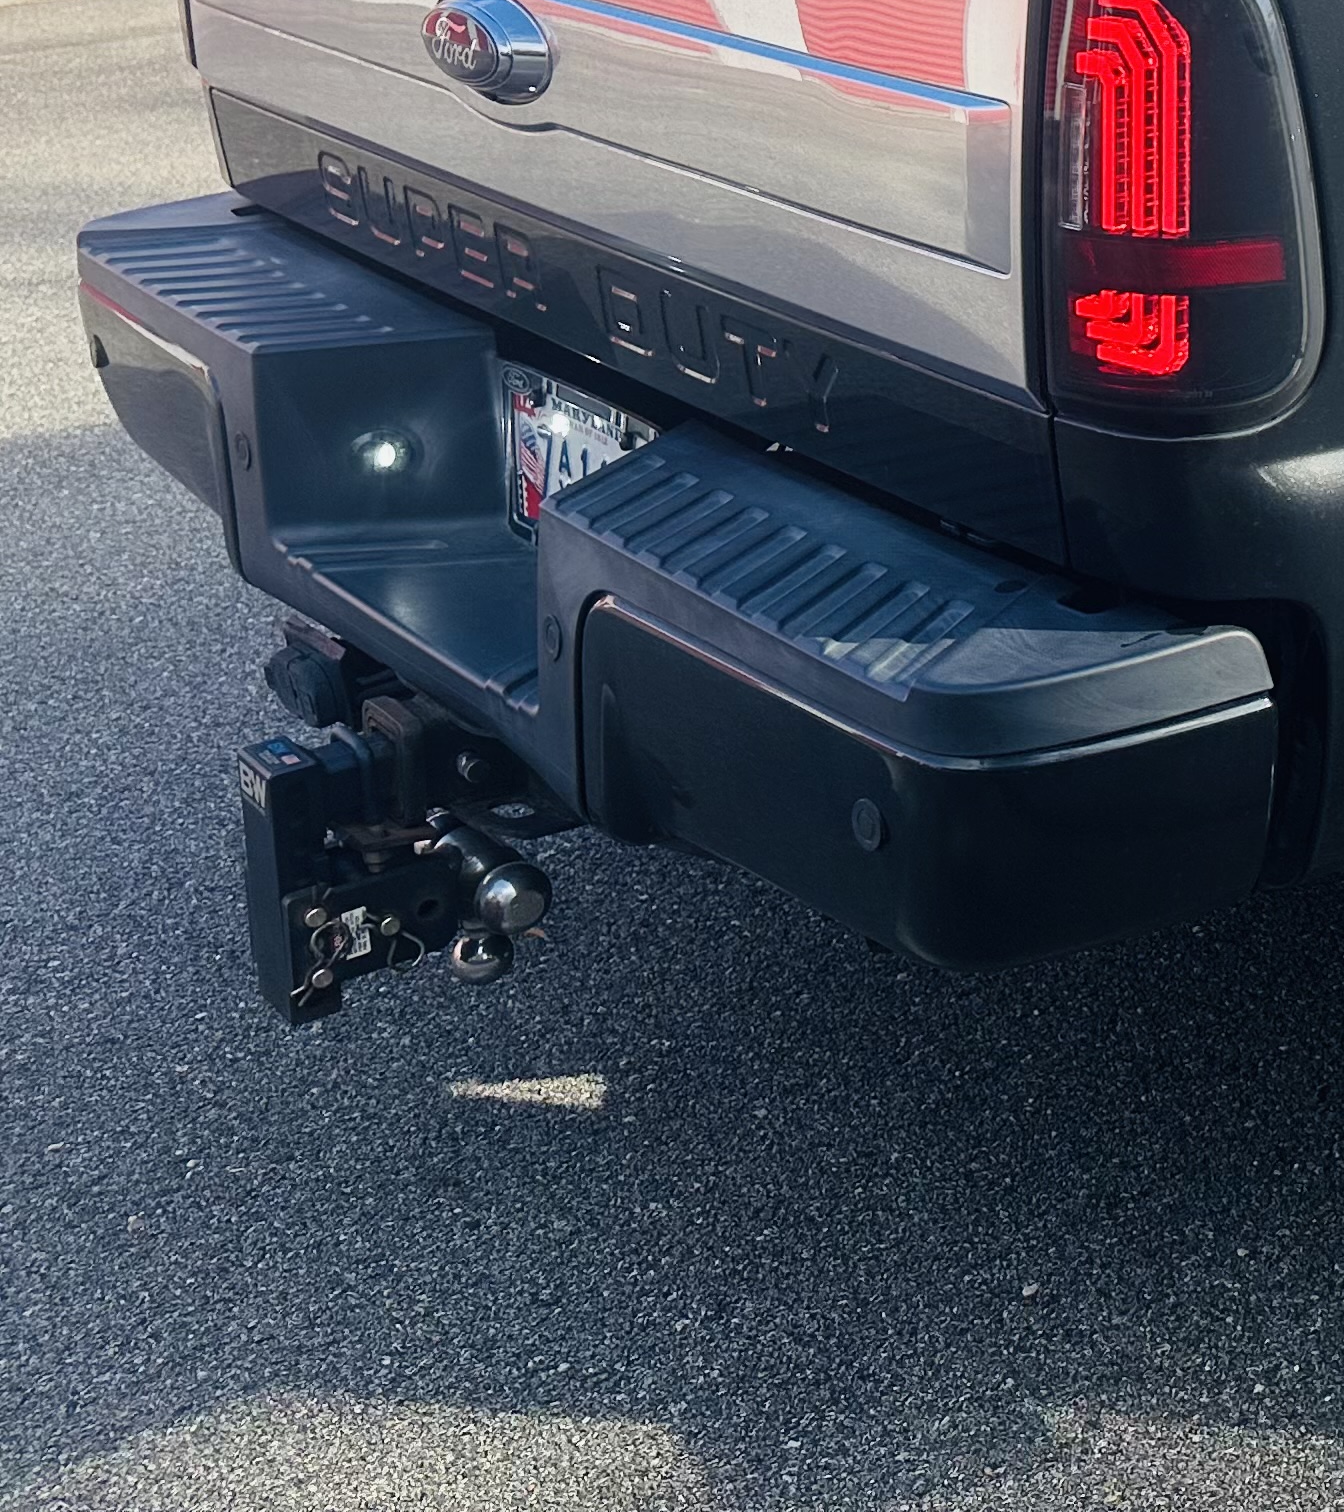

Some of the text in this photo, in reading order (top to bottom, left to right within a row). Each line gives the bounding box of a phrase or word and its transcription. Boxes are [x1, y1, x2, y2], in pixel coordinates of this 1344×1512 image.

[432, 16, 477, 70] Ford
[317, 150, 547, 311] SUPER
[595, 264, 840, 432] DUTY
